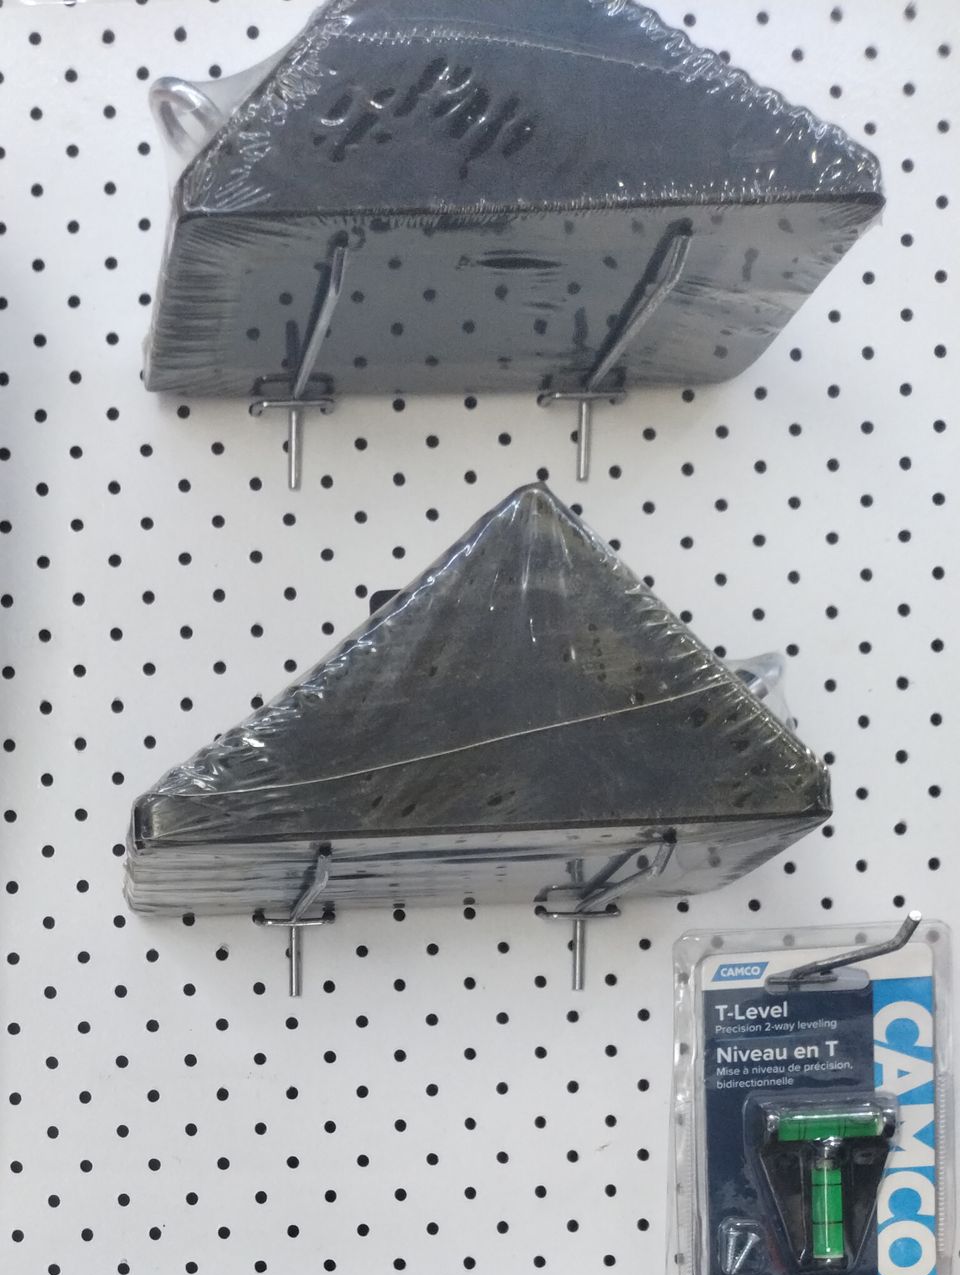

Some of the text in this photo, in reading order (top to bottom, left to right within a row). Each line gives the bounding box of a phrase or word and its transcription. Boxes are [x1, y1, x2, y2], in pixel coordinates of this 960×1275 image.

[720, 966, 760, 977] CAMCO
[715, 1001, 787, 1021] T-Level
[715, 1019, 838, 1034] Precision 2-way leveling
[717, 1041, 838, 1063] Niveau en T
[716, 1067, 740, 1076] Mise
[752, 1065, 785, 1074] niveau
[788, 1064, 801, 1072] de
[717, 1077, 794, 1088] bidirectionnelle
